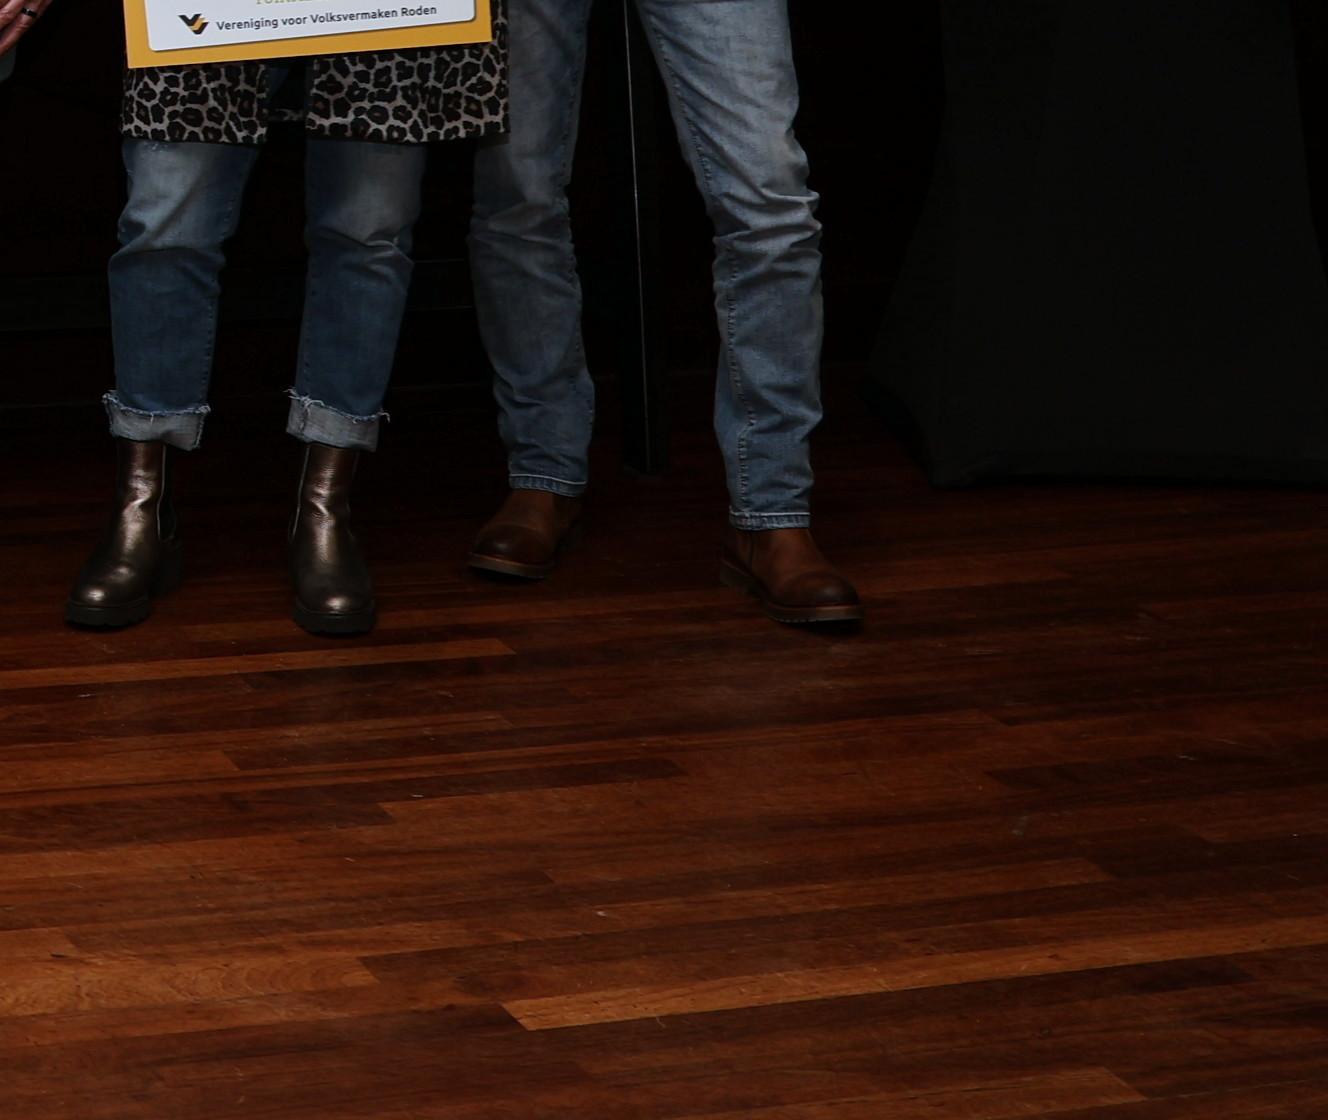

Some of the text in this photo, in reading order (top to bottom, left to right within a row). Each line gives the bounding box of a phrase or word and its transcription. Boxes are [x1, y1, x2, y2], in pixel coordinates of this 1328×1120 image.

[216, 5, 438, 31] Vereniging voor Volksvermaken Roden
